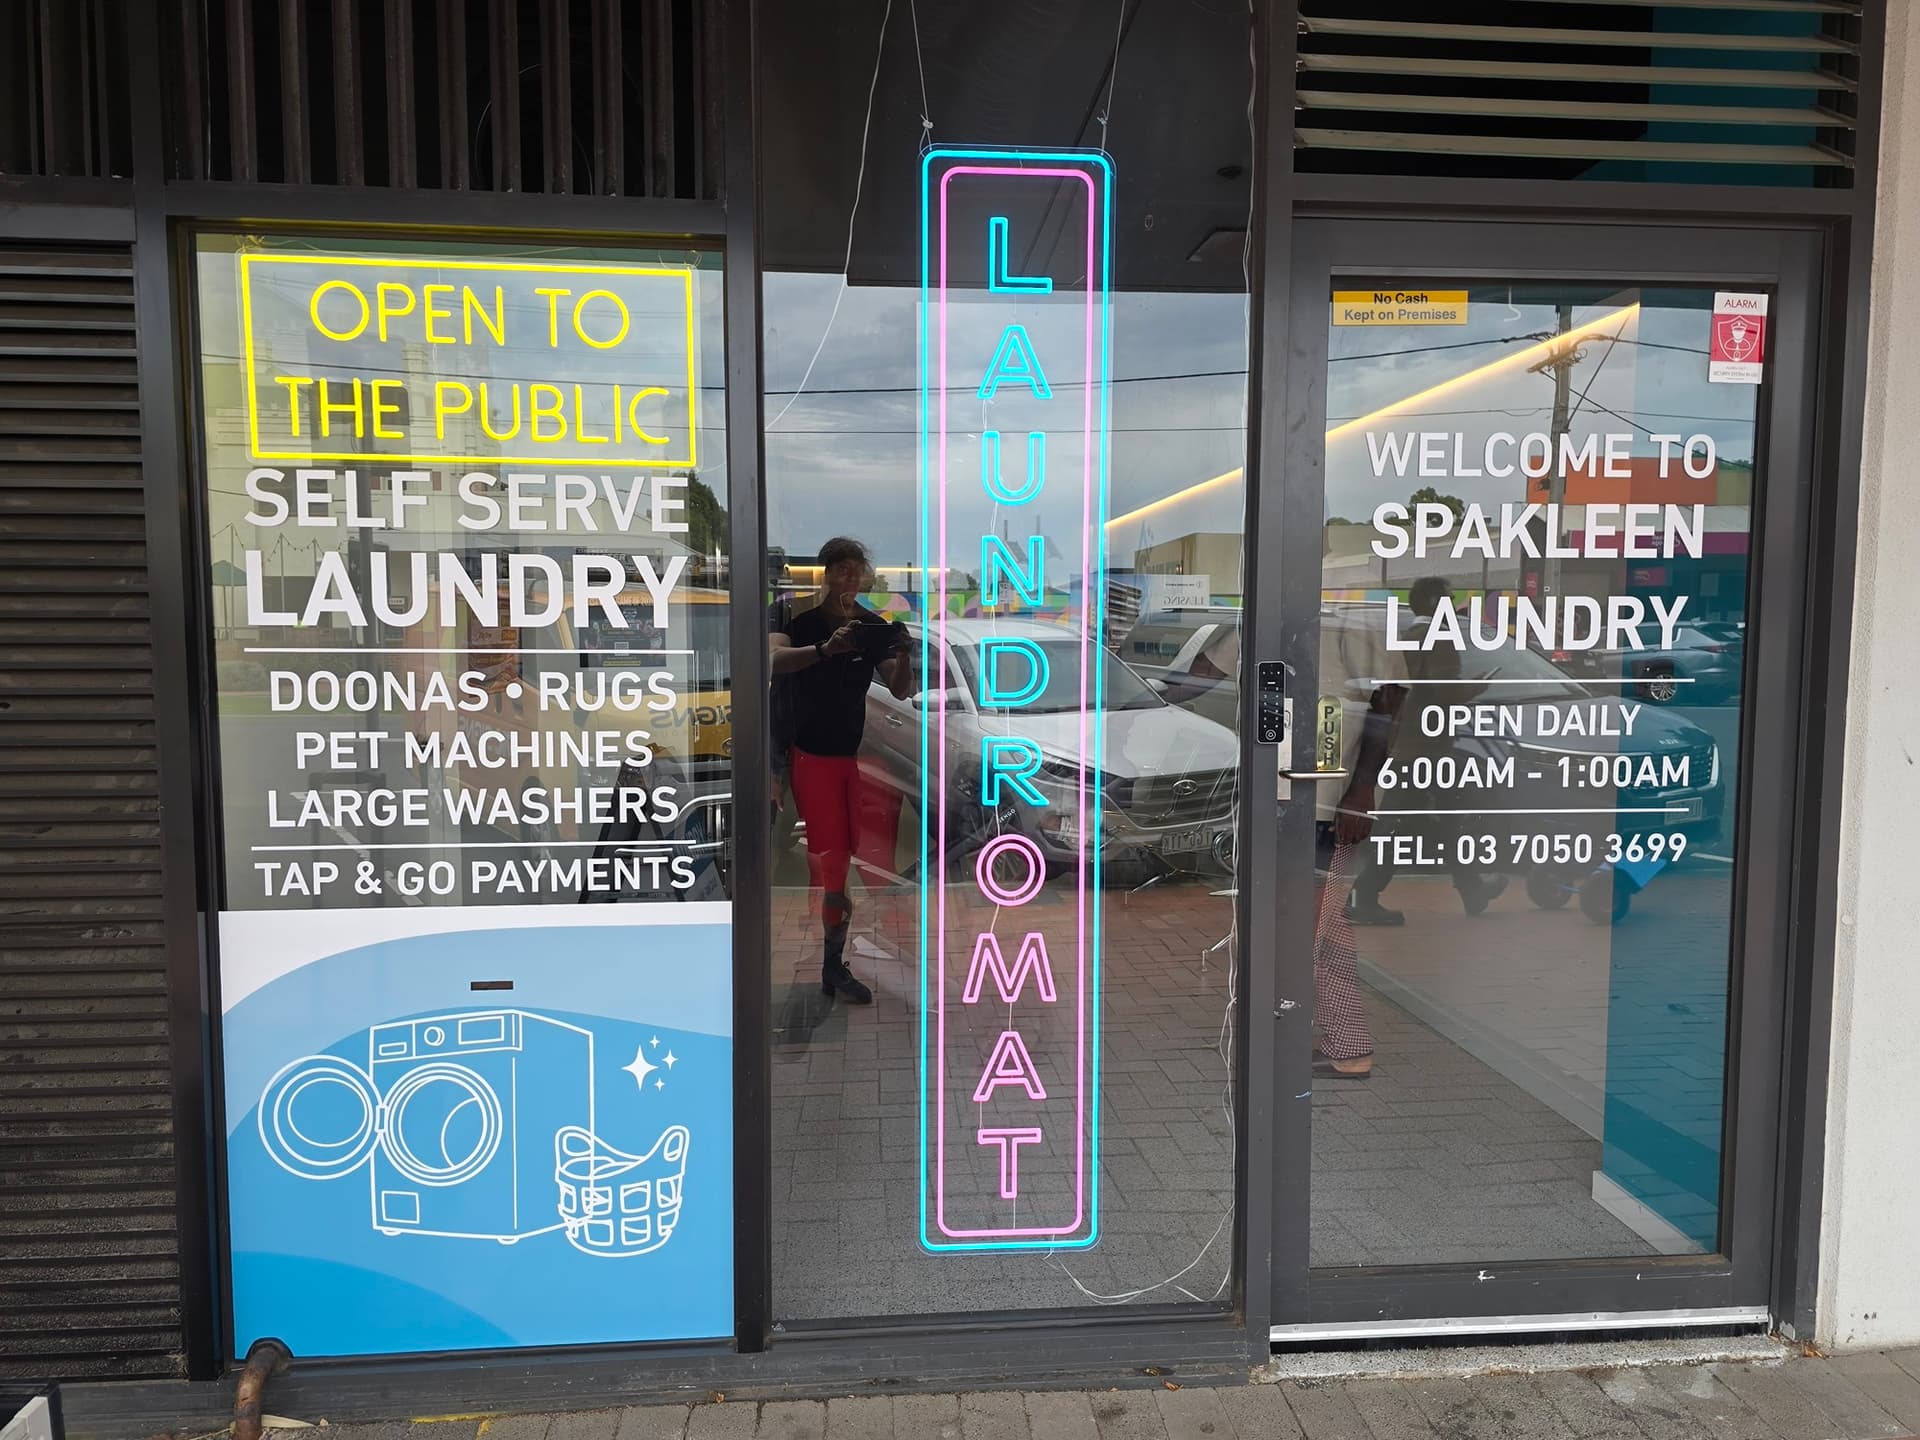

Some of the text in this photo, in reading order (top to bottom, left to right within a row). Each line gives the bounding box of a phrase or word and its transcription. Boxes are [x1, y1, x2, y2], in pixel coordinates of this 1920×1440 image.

[309, 279, 631, 350] OPEN TO
[1344, 308, 1456, 323] Kept on Premises
[1374, 293, 1428, 304] No Cash
[1724, 299, 1757, 309] ALARM
[273, 375, 670, 446] THE PUBLIC
[1365, 431, 1716, 479] WELCOME TO
[244, 468, 689, 533] SELF SERVE
[1370, 502, 1705, 559] SPAKLEEN
[245, 550, 689, 629] LAUNDRY
[1385, 596, 1689, 651] LAUNDRY
[270, 670, 490, 712] DOONAS
[539, 671, 677, 711] RUGS
[962, 216, 1057, 1199] LAUNDROMAT
[1323, 706, 1335, 765] PUSH
[1421, 704, 1641, 737] OPEN DAILY
[296, 730, 653, 770] PET MACHINES
[1376, 756, 1515, 789] 6:00AM
[1557, 755, 1690, 788] 1:00AM
[268, 786, 680, 828] LARGE WASHERS
[1370, 833, 1687, 866] TEL: 03 7050 3699
[254, 855, 697, 897] TAP & GO PAYMENTS
